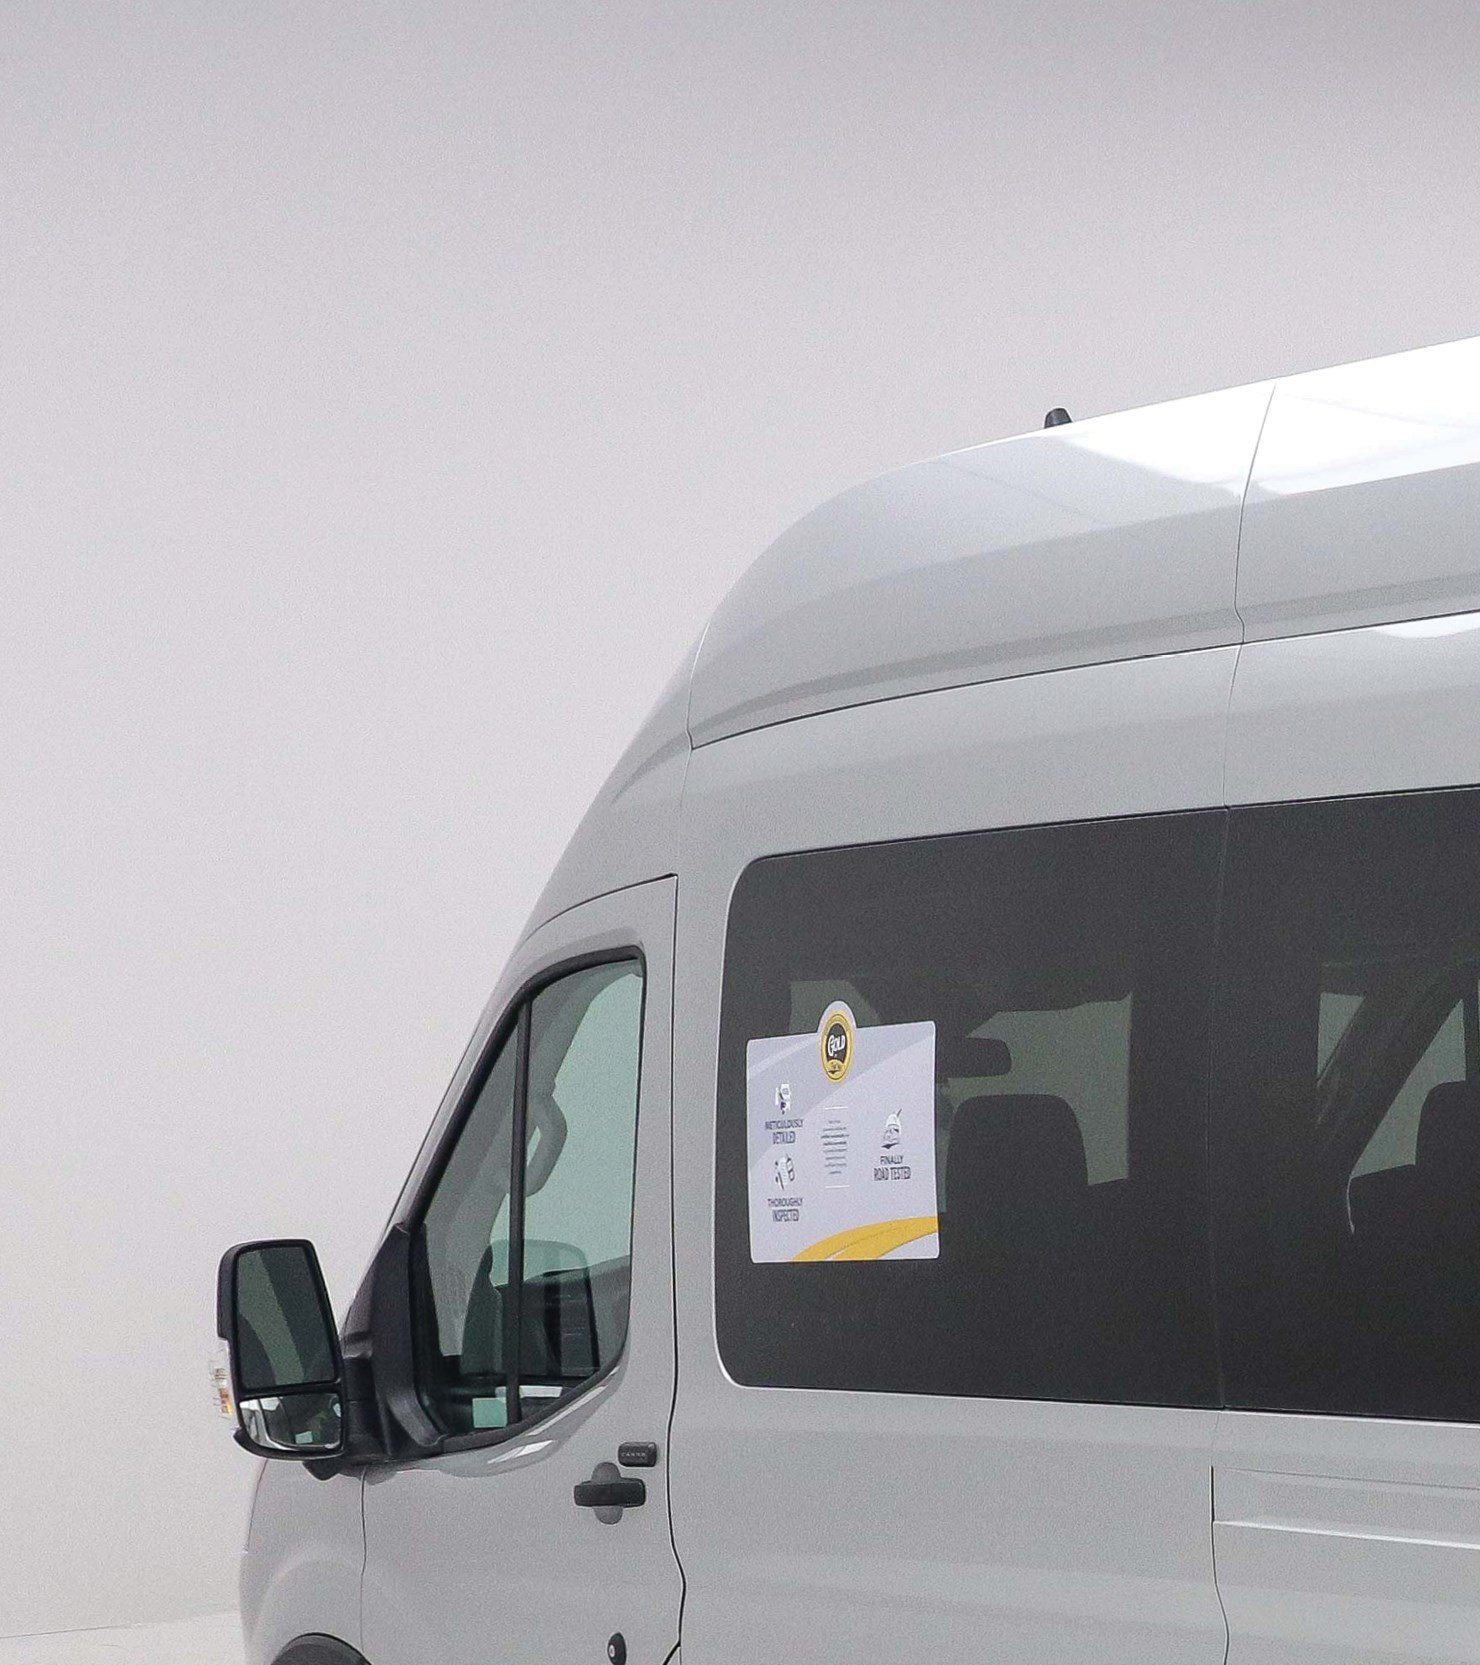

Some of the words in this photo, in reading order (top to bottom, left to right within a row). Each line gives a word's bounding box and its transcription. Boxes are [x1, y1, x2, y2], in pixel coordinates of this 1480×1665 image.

[827, 1034, 846, 1056] GOLD
[880, 1155, 903, 1164] FINALLY
[873, 1167, 889, 1180] ROAD
[890, 1166, 911, 1180] TESTED
[767, 1197, 803, 1207] THOROUGHLY
[773, 1209, 799, 1222] INSPECTED
